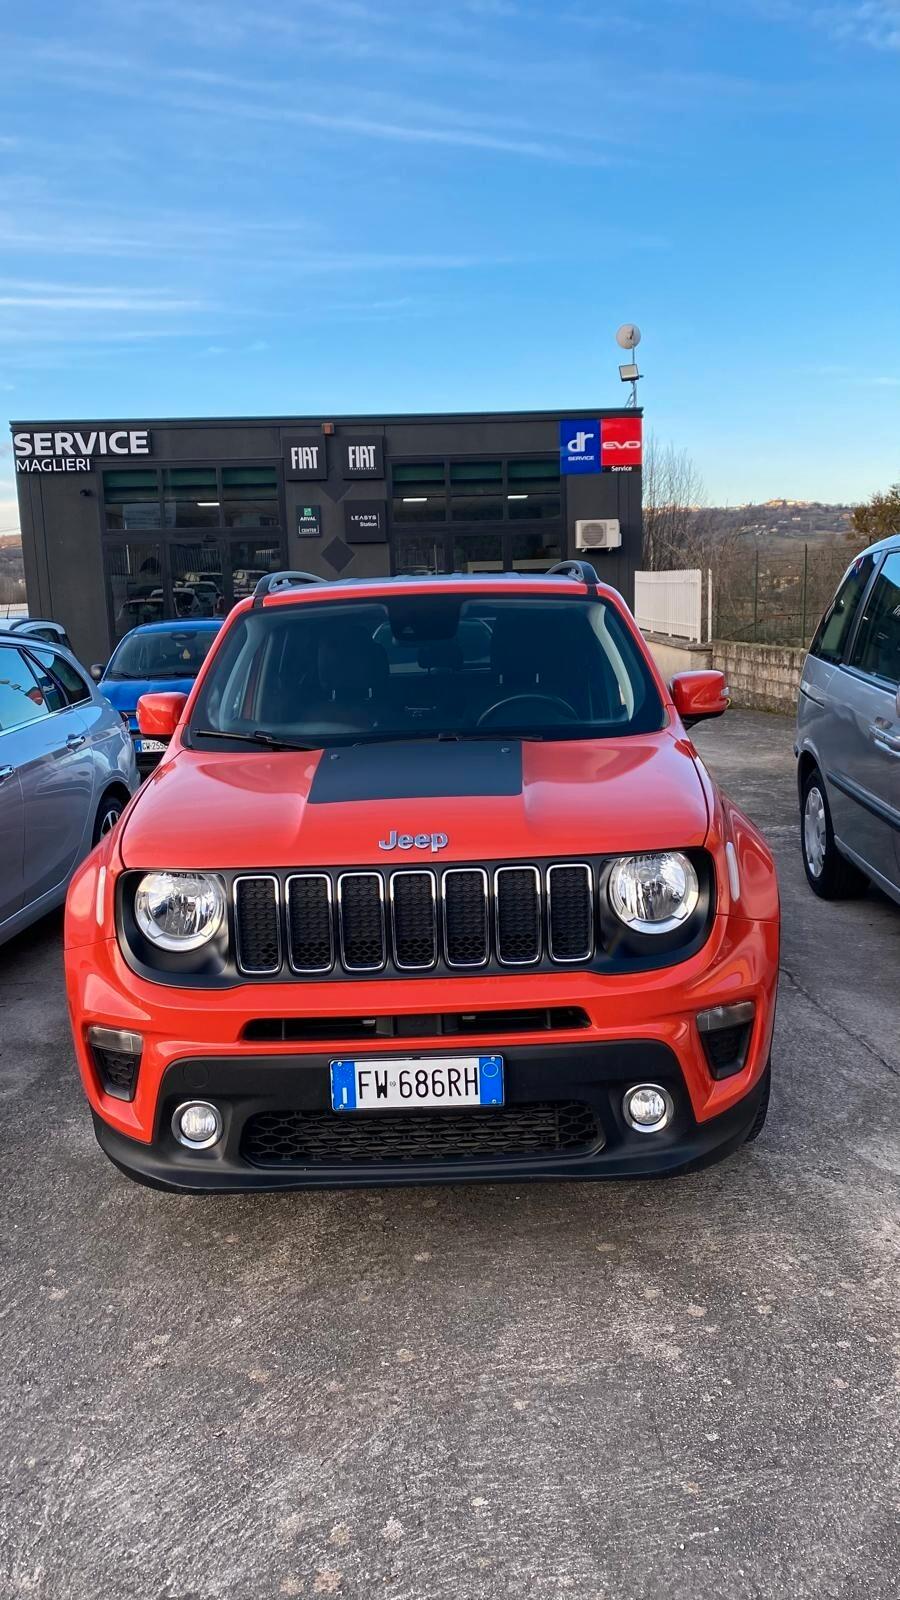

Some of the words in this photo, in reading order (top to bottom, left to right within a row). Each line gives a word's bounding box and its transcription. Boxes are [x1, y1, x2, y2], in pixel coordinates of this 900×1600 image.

[14, 431, 149, 455] SERVICE
[567, 432, 594, 452] dr
[16, 458, 90, 472] MAGLIERI
[291, 447, 318, 469] FIAT
[348, 446, 375, 468] FIAT
[379, 831, 448, 852] Jeep
[358, 1070, 388, 1099] FW
[399, 1068, 479, 1098] 686RH
